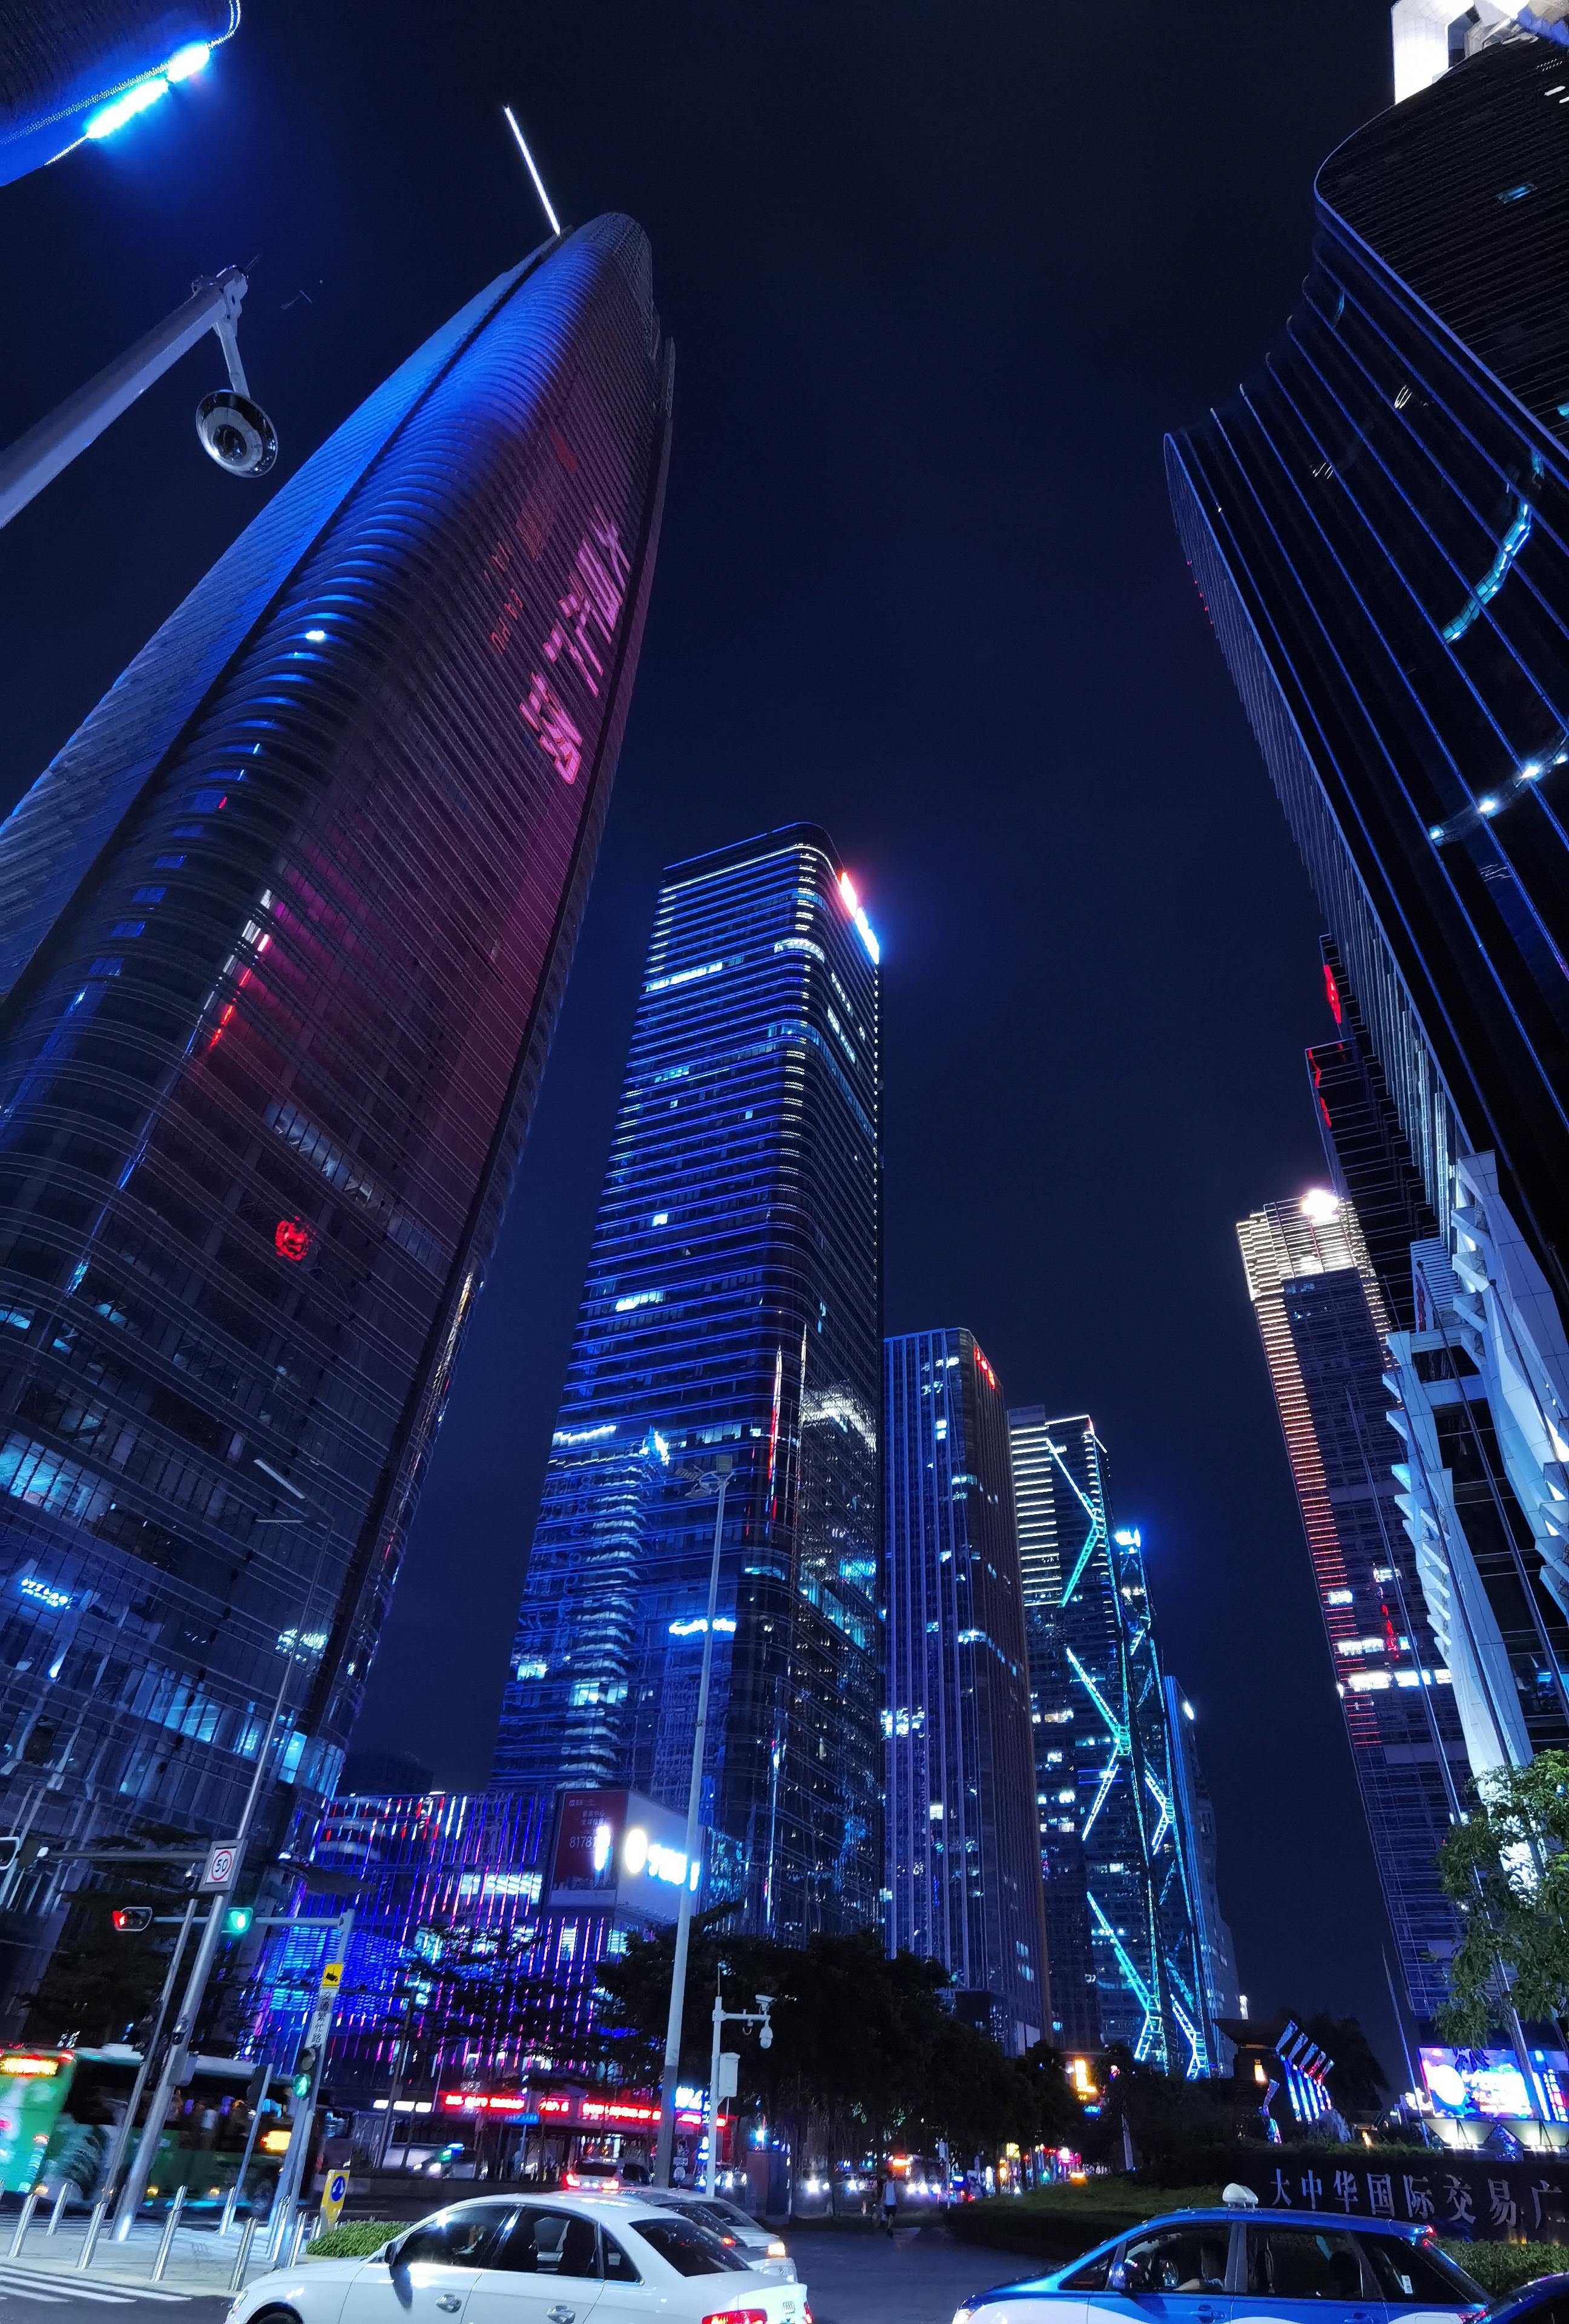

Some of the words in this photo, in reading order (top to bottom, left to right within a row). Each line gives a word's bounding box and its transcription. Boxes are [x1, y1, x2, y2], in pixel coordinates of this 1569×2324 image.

[215, 1858, 228, 1873] 50
[311, 1991, 331, 2049] 交通繁忙路
[1271, 2168, 1562, 2229] 大中华国际交易广
